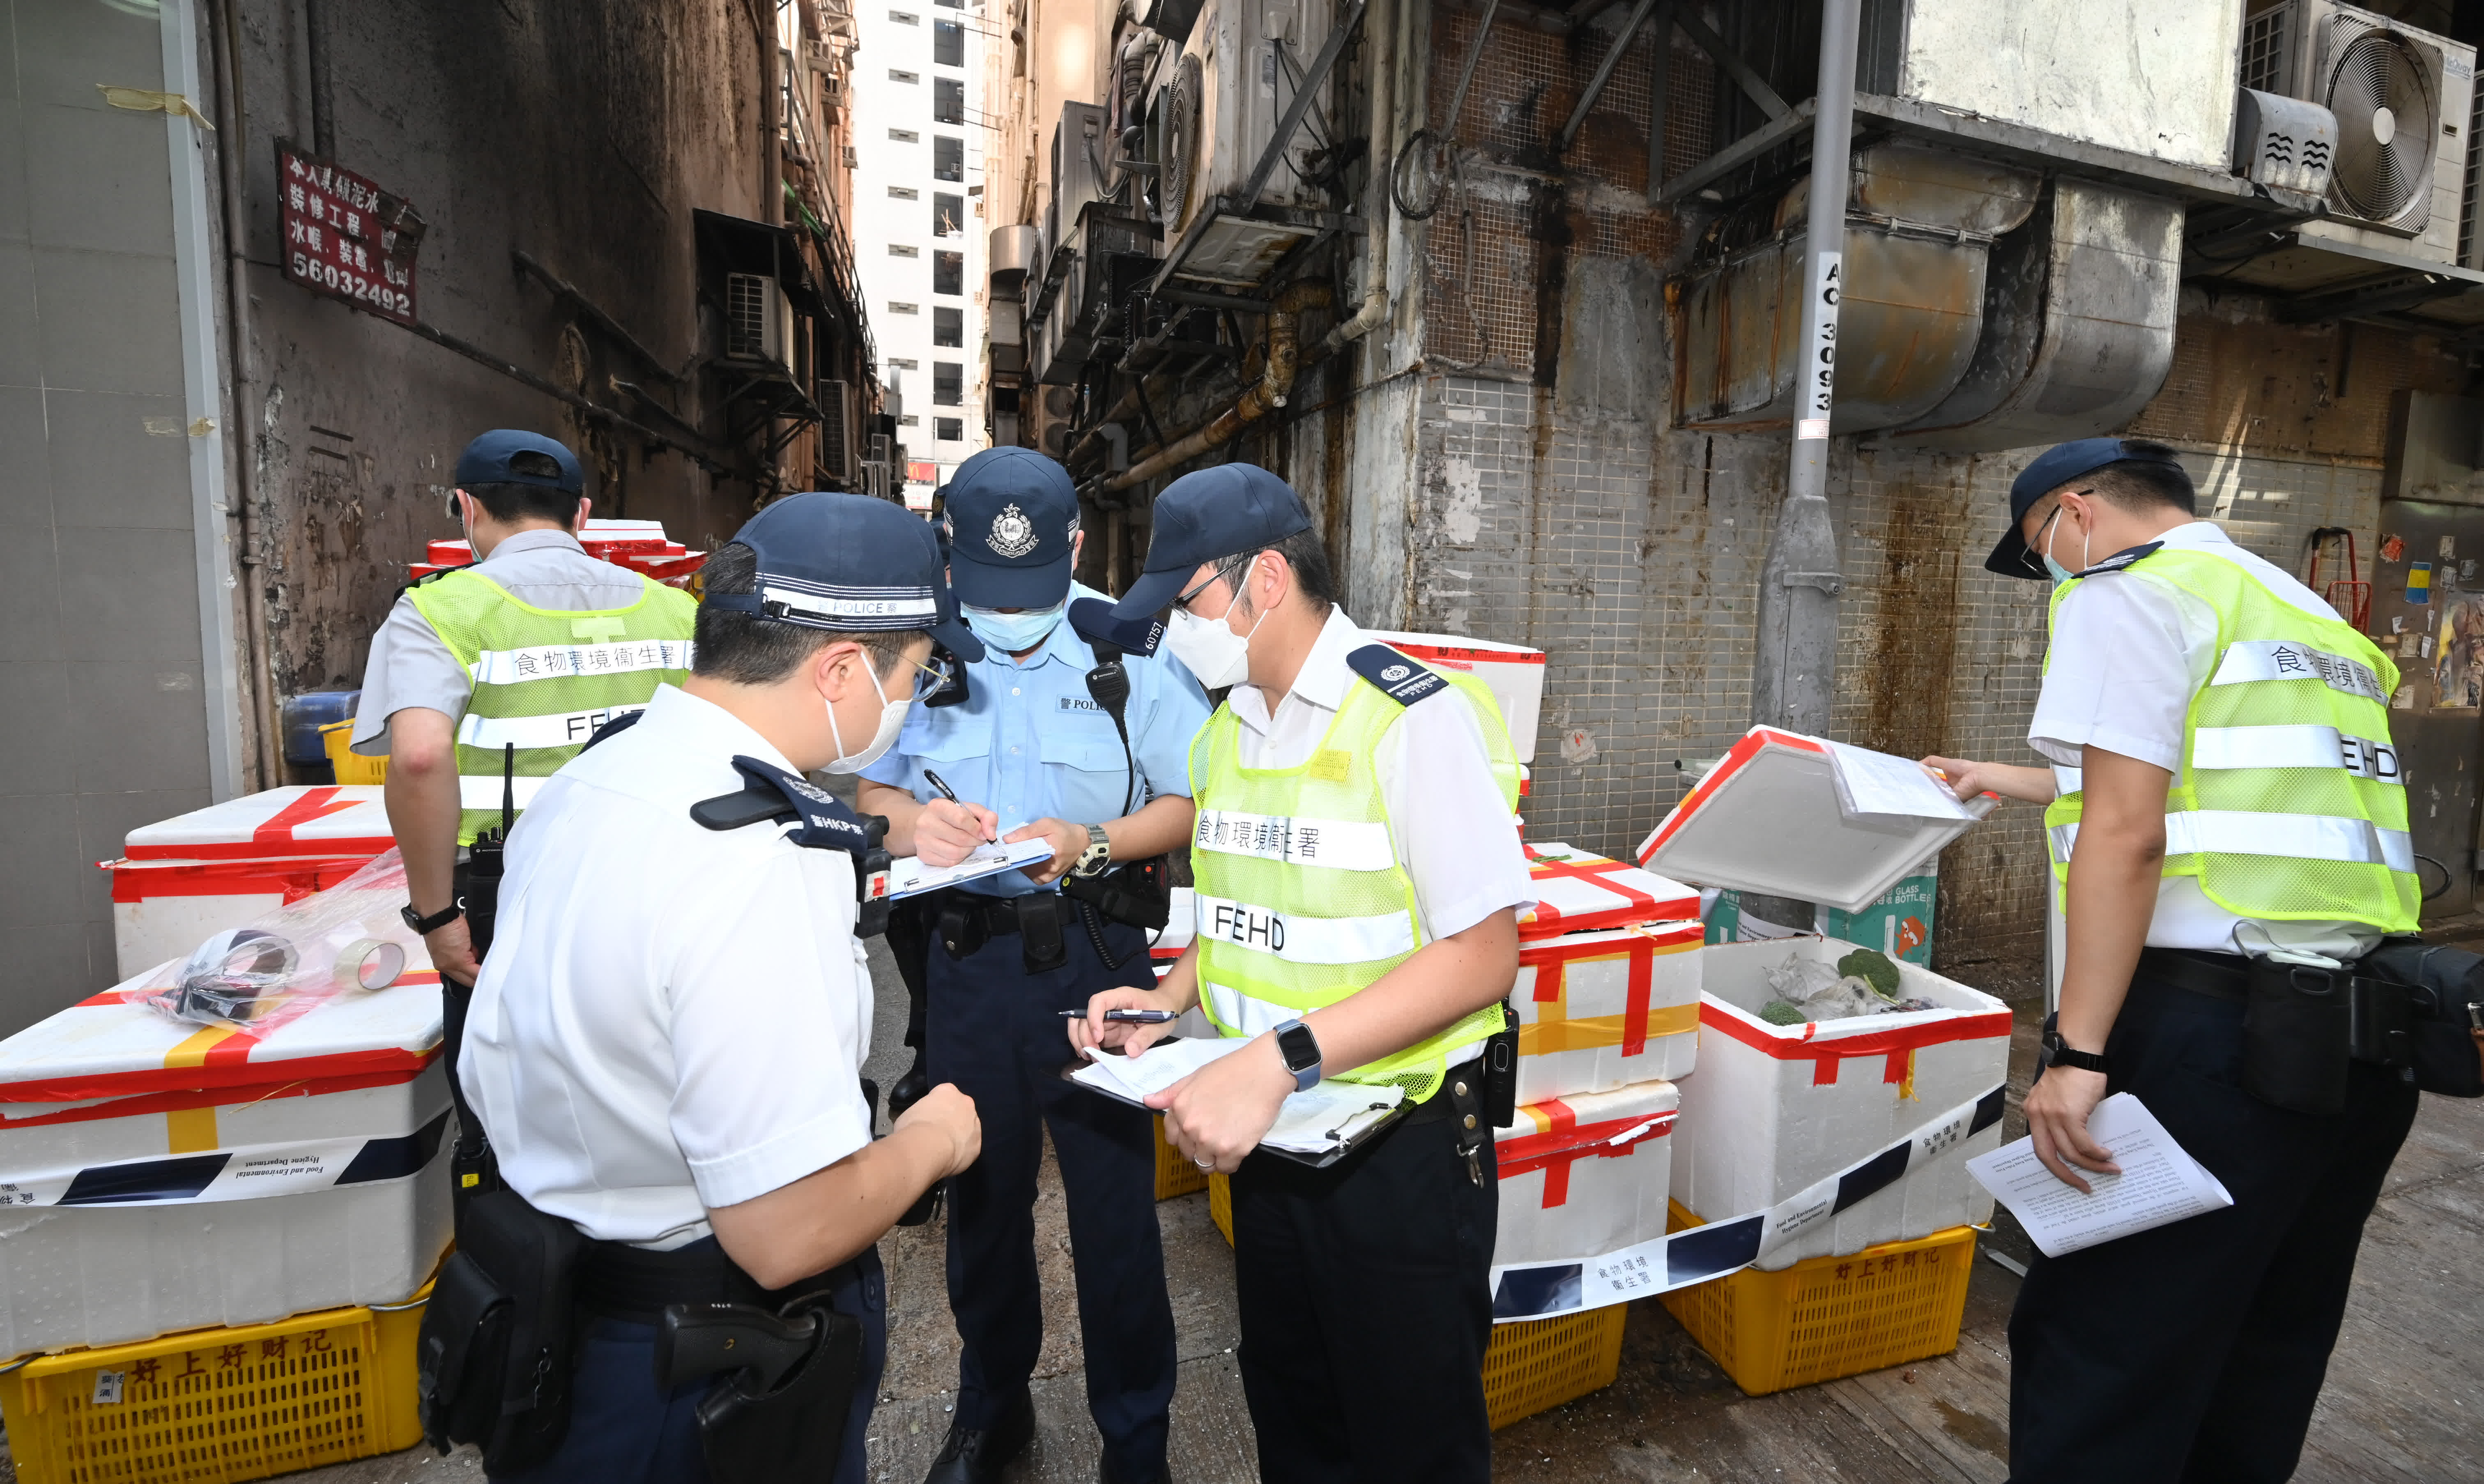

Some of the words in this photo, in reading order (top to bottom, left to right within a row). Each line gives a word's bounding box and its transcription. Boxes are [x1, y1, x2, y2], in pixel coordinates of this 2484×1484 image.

[293, 251, 410, 316] 56032492
[1817, 323, 1836, 411] 3093
[833, 603, 883, 613] POLICE
[1145, 621, 1162, 649] 60757
[1410, 683, 1433, 696] FEHD
[1060, 697, 1071, 709] 警
[1074, 699, 1106, 711] POLI
[1896, 885, 1919, 895] GLASS
[1895, 893, 1932, 904] BOTTLES
[1216, 906, 1284, 951] FEHD
[245, 1158, 288, 1167] Department
[291, 1155, 320, 1164] Hygiene
[236, 1169, 289, 1179] Environmental
[1776, 1219, 1787, 1229] Food
[1787, 1215, 1796, 1223] and
[1796, 1199, 1827, 1218] Environmental
[1782, 1222, 1799, 1234] Hygiene
[1800, 1209, 1824, 1225] Department
[1597, 1256, 1648, 1279] 食物環境
